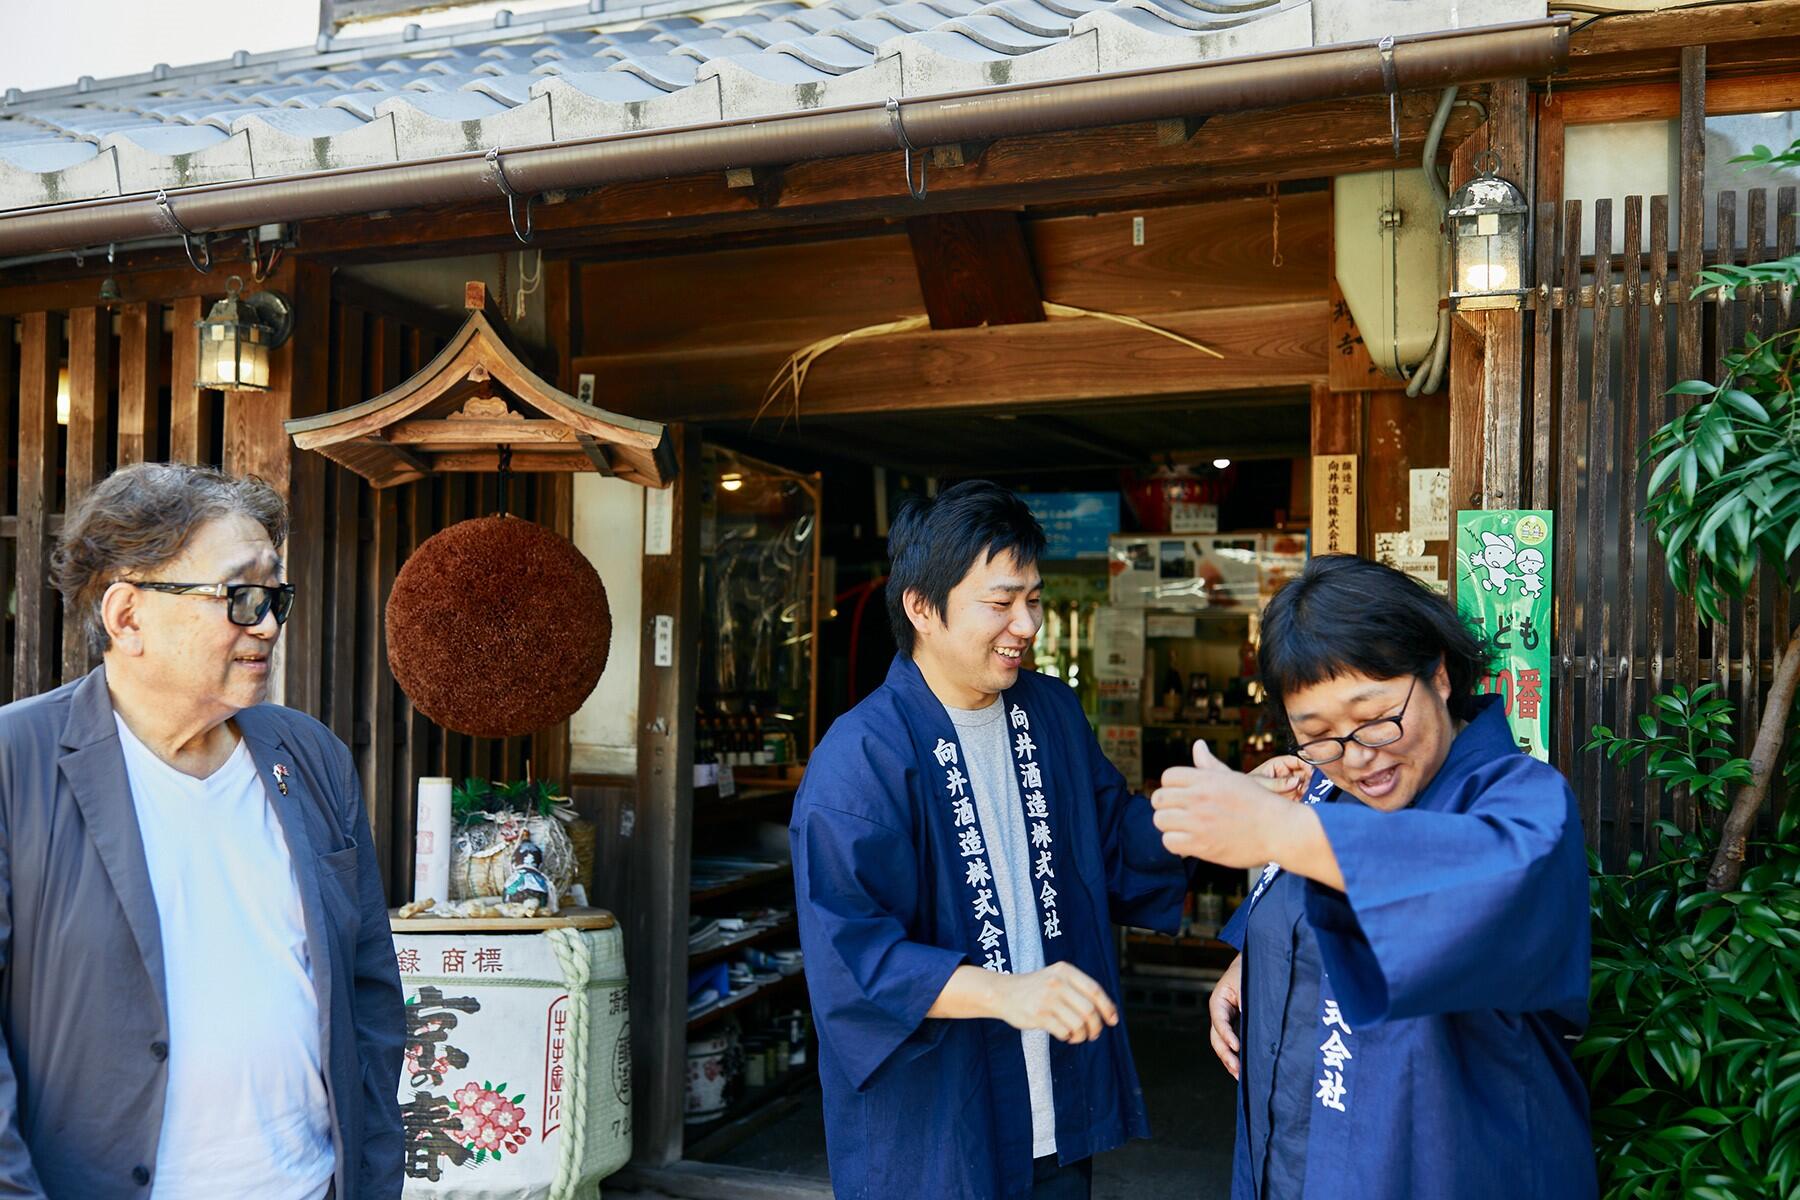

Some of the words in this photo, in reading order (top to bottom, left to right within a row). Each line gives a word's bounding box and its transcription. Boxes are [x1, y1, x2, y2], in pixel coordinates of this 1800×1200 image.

[1328, 460, 1339, 551] 向井酒造株式会社
[932, 737, 1012, 975] 向井酒造株式会社
[1009, 703, 1063, 940] 向井酒造株式会社
